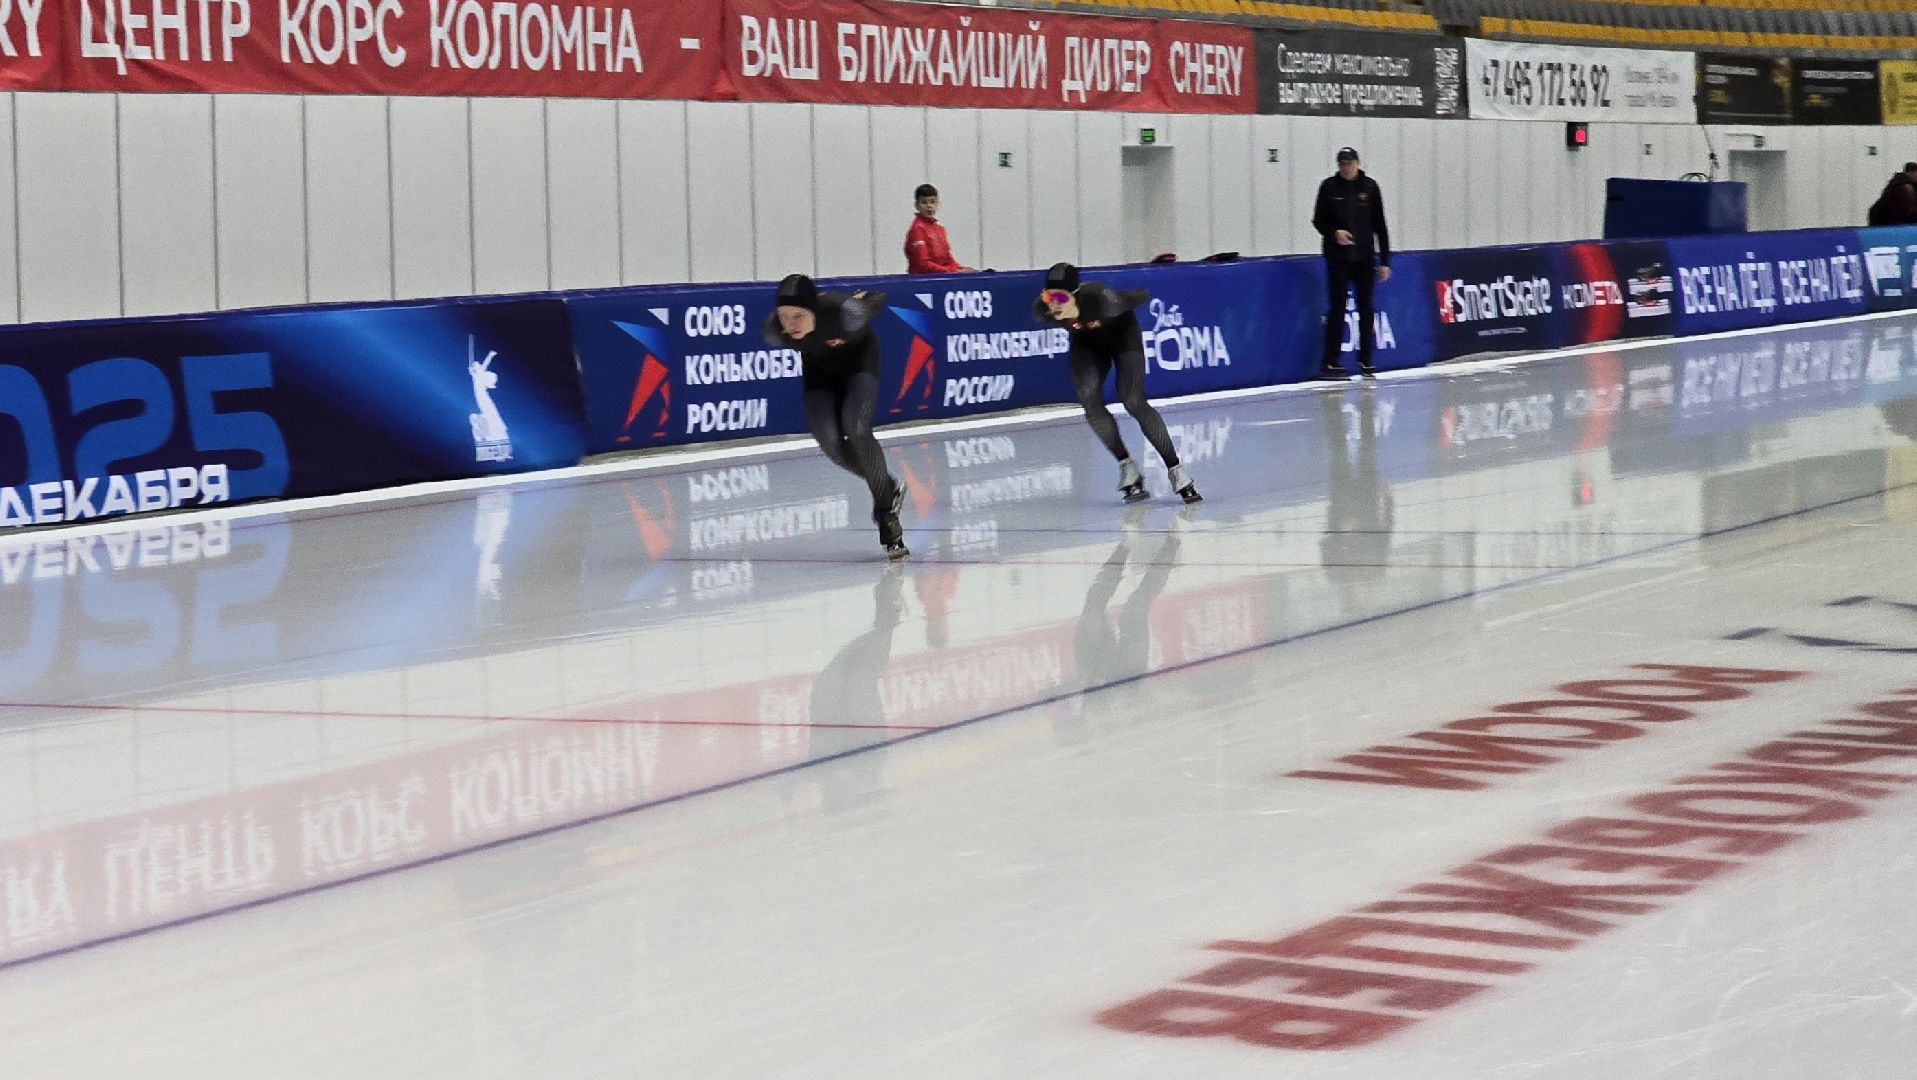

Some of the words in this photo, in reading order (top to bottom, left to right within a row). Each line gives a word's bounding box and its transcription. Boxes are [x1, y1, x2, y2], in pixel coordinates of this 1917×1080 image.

[81, 0, 251, 75] ЦЕНТР
[279, 0, 406, 68] КОРС
[430, 2, 643, 73] КОЛОМНА
[740, 15, 820, 81] ВАШ
[837, 17, 1048, 90] БЛИЖАЙШИЙ
[1062, 36, 1151, 103] ДИЛЕР
[1168, 40, 1244, 97] CHERY
[944, 290, 992, 319] СОЮЗ
[1452, 275, 1553, 322] SmartSkate
[684, 304, 746, 337] СОЮЗ
[946, 327, 1070, 363] КОНЬКОБЕЖЦЕВ
[1141, 325, 1231, 374] FORMA
[943, 374, 1014, 407] РОССИИ
[686, 398, 768, 434] РОССИИ
[0, 463, 229, 528] ДЕКАБРЯ
